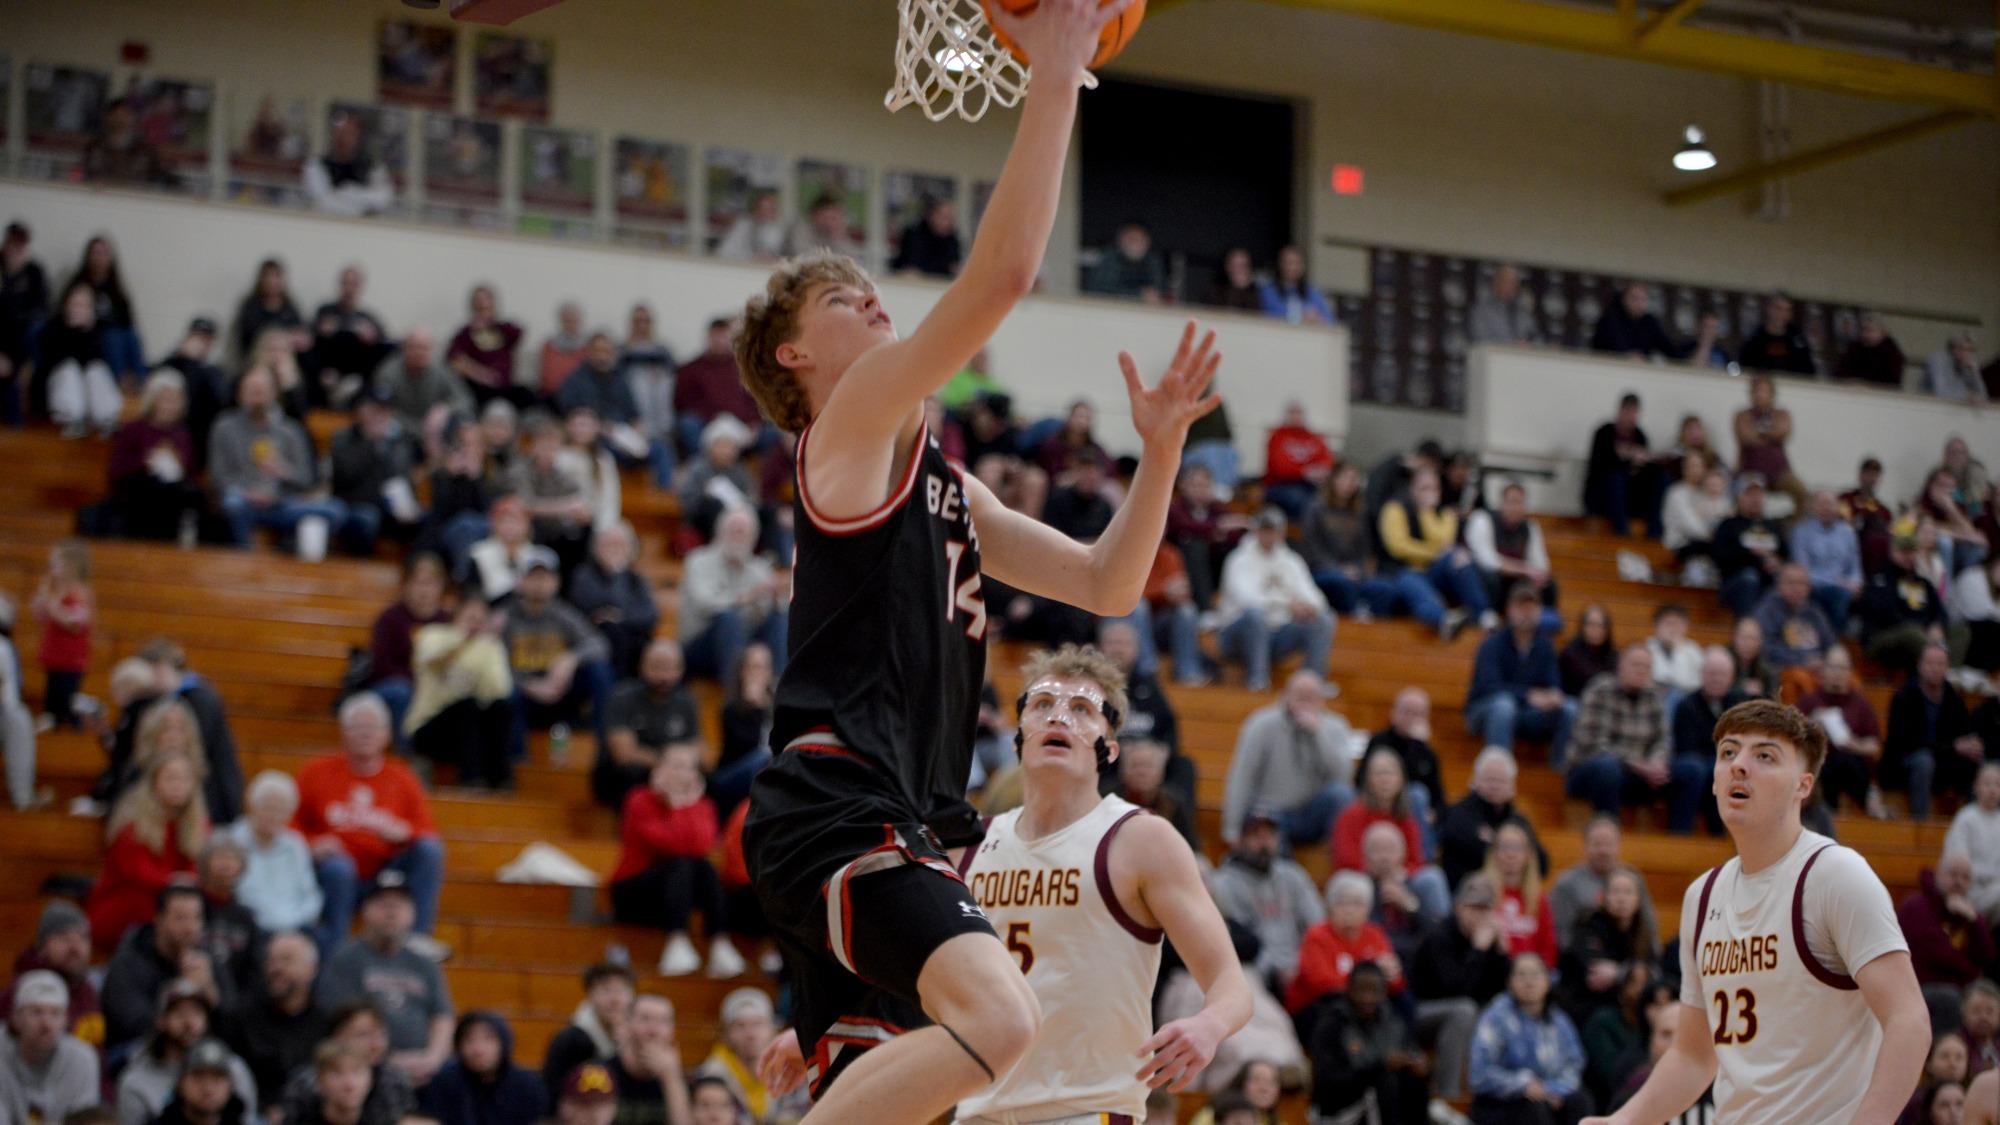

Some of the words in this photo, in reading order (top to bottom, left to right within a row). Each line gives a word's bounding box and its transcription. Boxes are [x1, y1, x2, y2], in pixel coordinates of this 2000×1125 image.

[946, 540, 986, 641] 14
[971, 868, 1081, 908] COUGARS
[1007, 920, 1035, 977] 5
[1702, 933, 1778, 977] COUGARS
[1714, 987, 1758, 1045] 23
